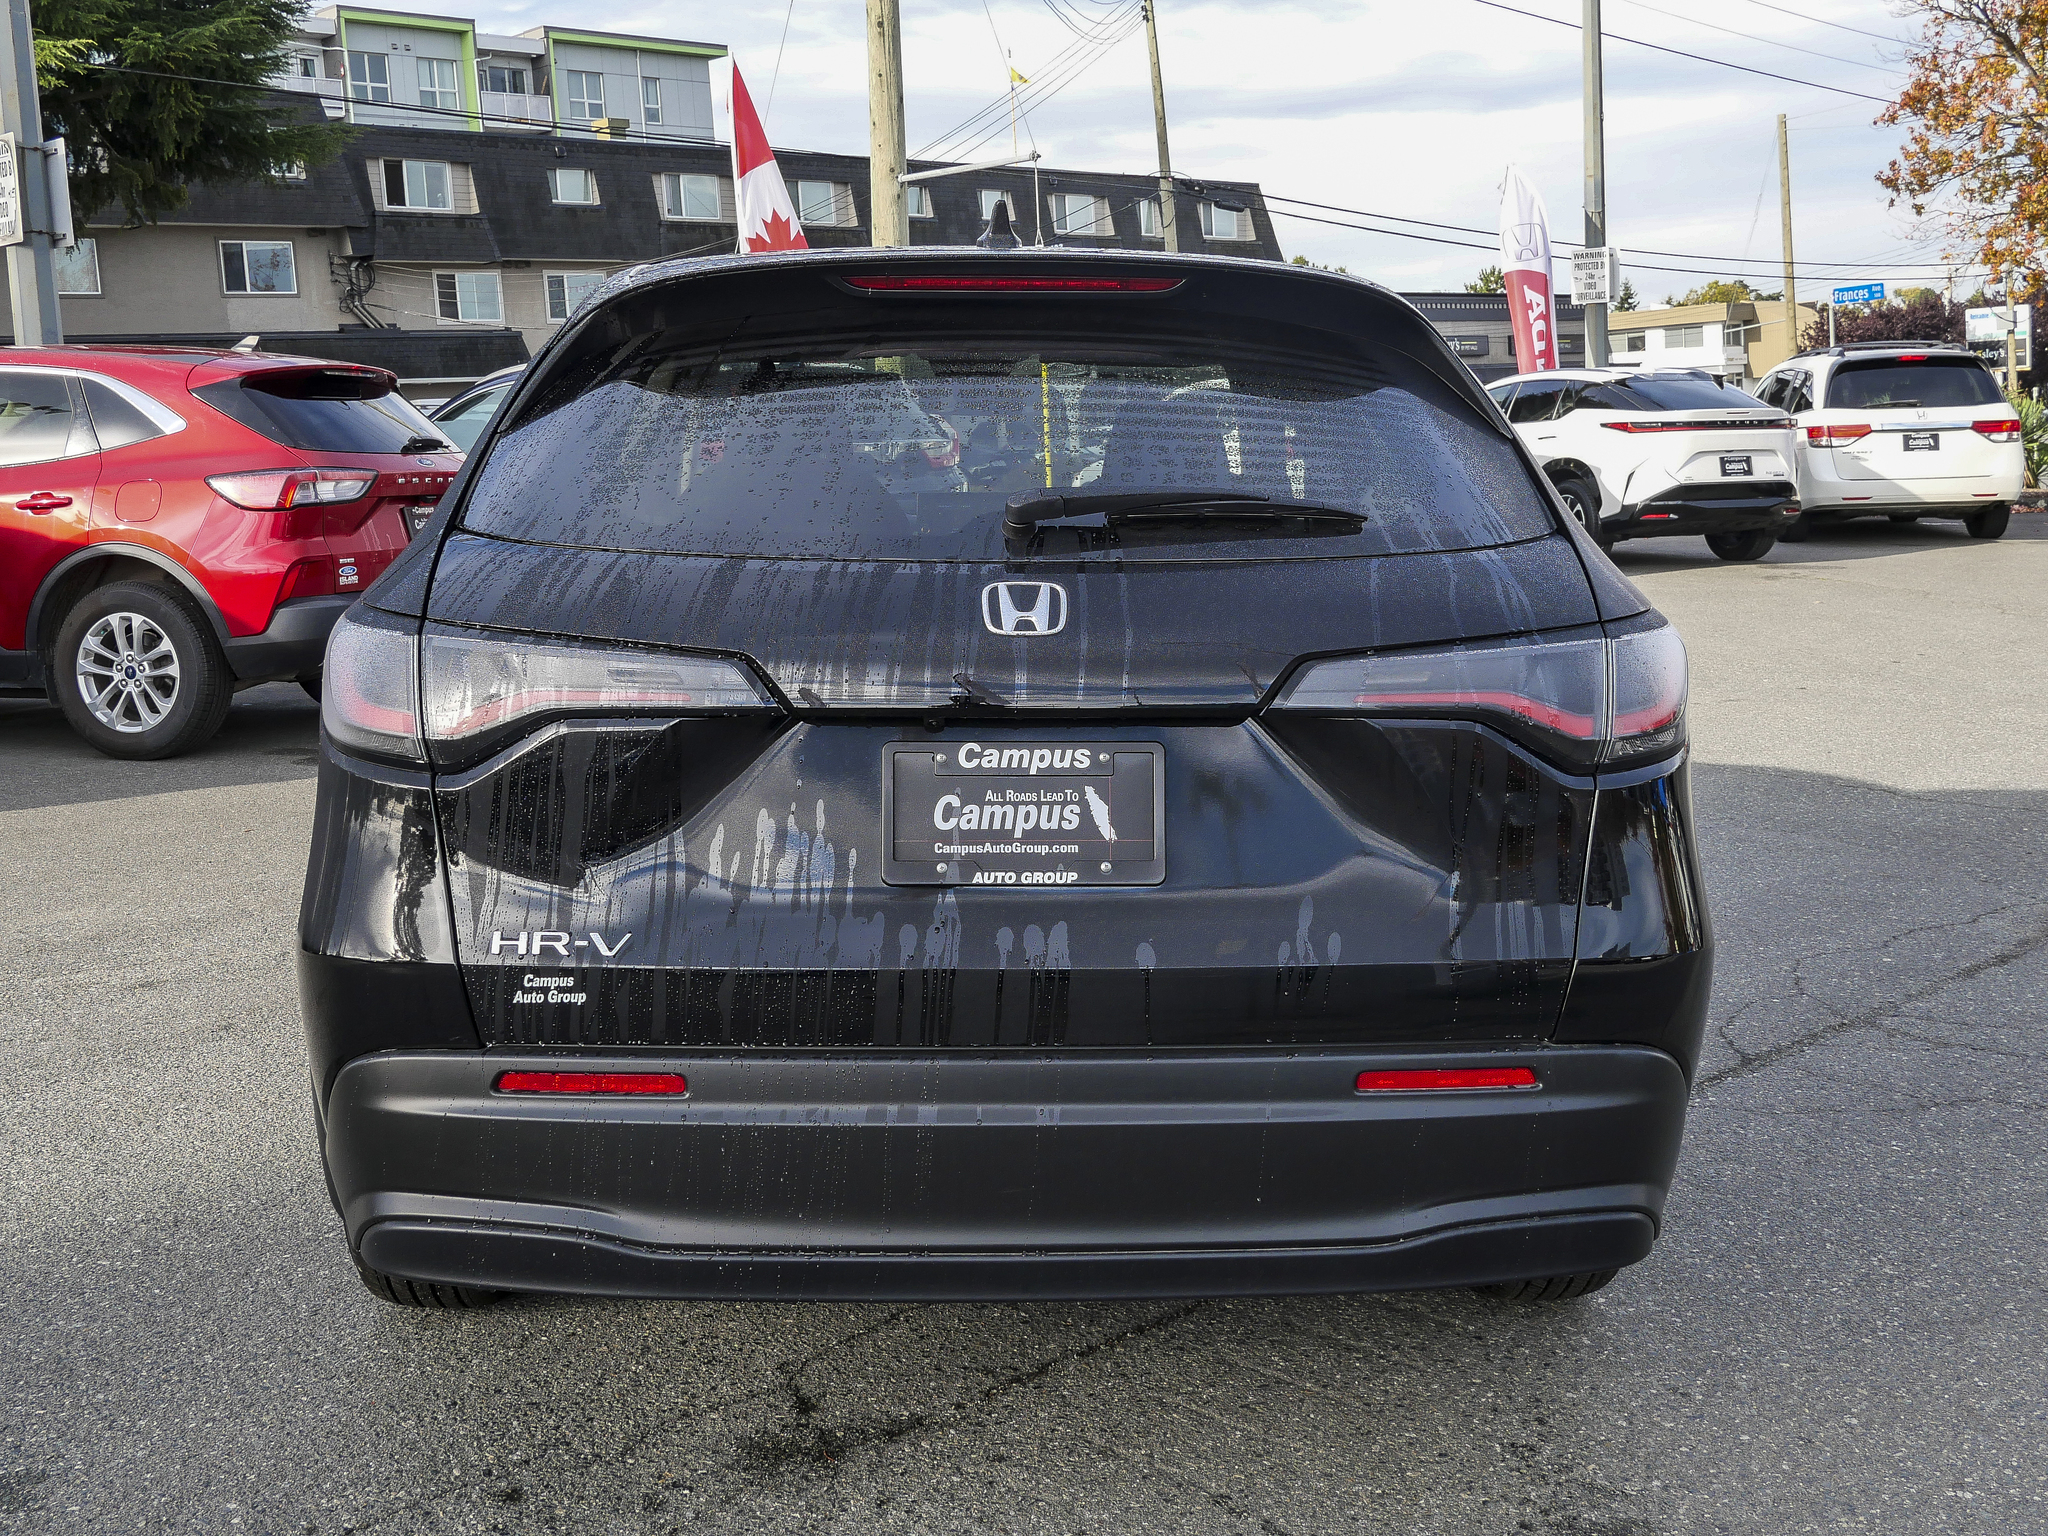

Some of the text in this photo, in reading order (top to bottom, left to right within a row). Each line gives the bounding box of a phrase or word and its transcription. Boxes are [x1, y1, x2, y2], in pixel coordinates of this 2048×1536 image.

[1573, 251, 1606, 260] WARNING
[1574, 261, 1599, 271] PROTECTED
[1584, 281, 1597, 290] VIDEO
[1834, 289, 1869, 302] Frances
[958, 742, 1091, 774] Campus
[933, 794, 1081, 838] Campus
[934, 842, 1079, 855] CampusAutoGroup.com
[972, 872, 1078, 884] AUTO GROUP
[491, 930, 632, 956] HR-V
[523, 974, 574, 989] Campus
[513, 990, 587, 1005] Auto Group
